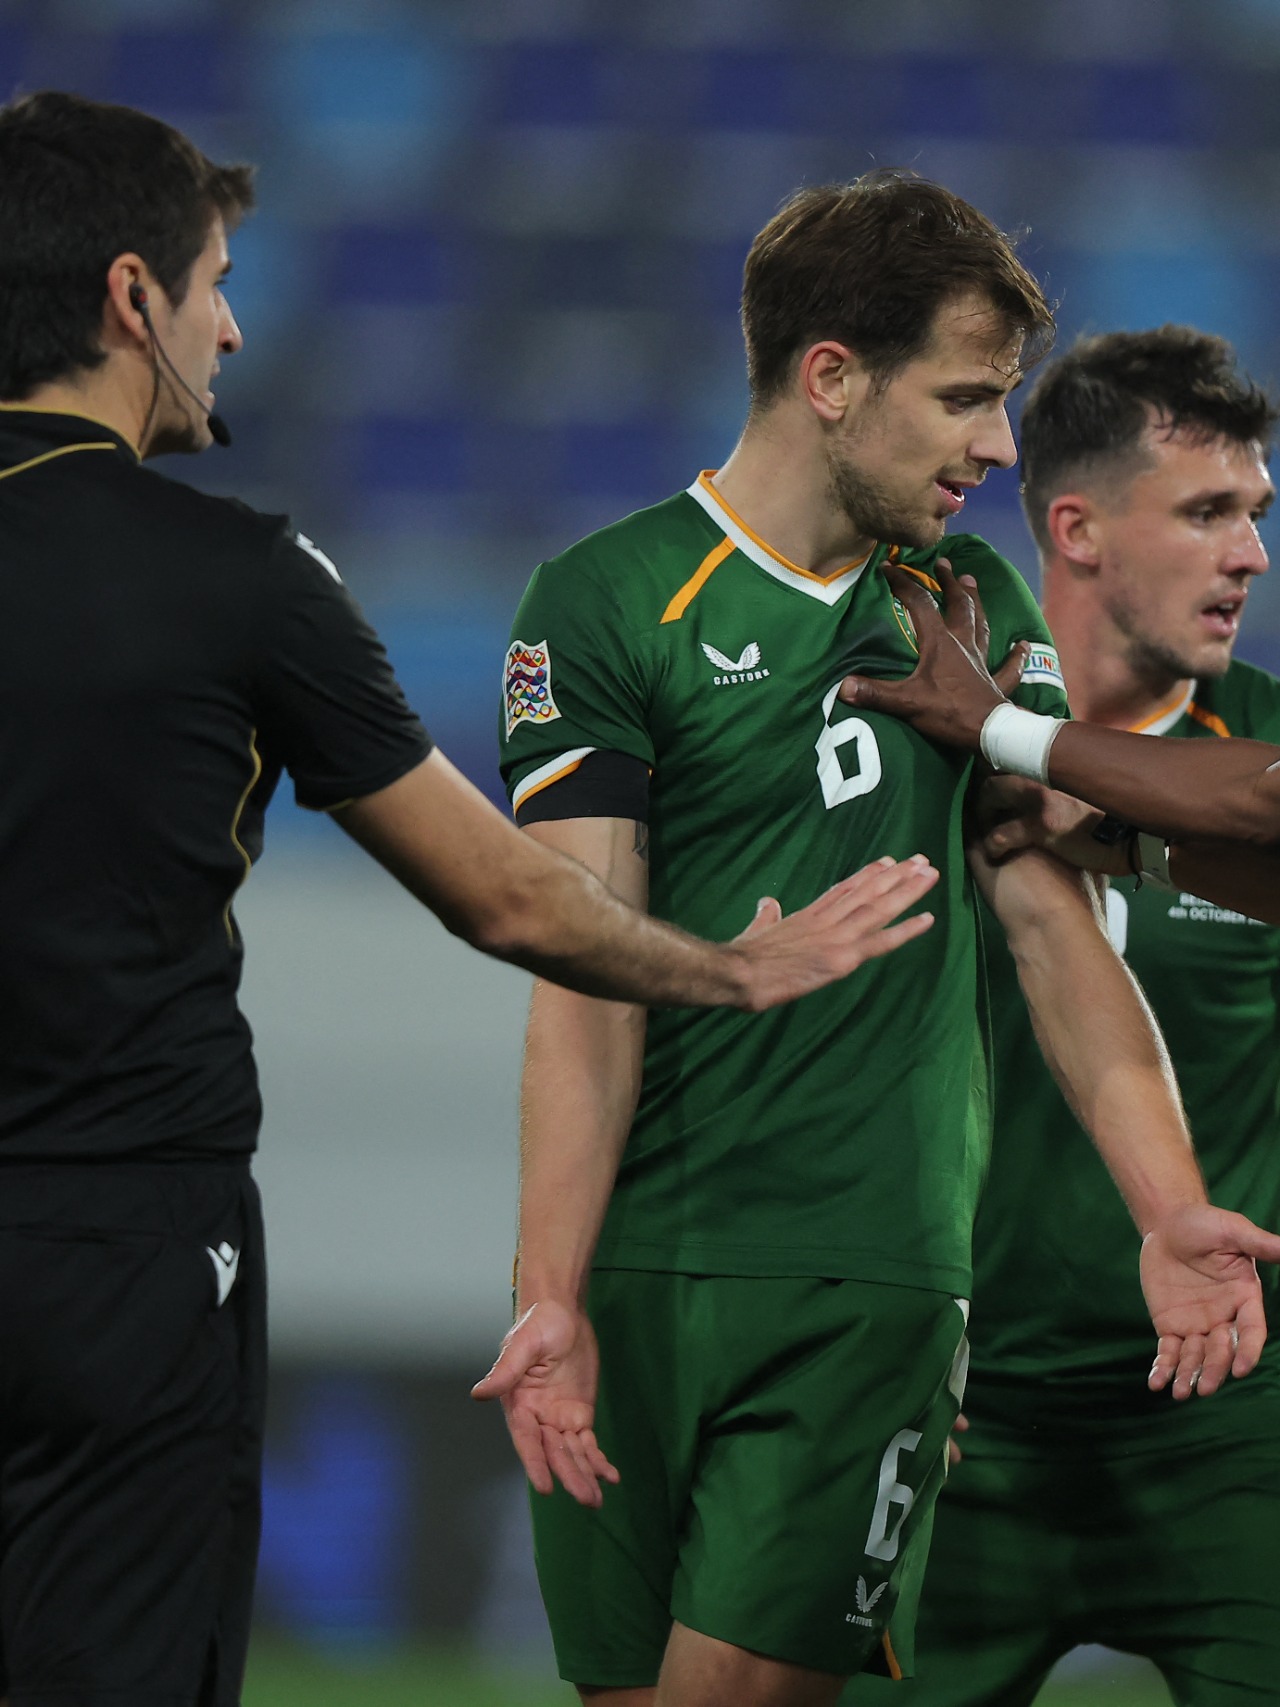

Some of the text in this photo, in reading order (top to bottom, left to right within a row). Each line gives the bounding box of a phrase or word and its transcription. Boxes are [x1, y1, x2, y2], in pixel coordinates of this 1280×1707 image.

[815, 680, 882, 810] 6
[1189, 906, 1247, 925] OCTOBER
[864, 1428, 922, 1562] 6
